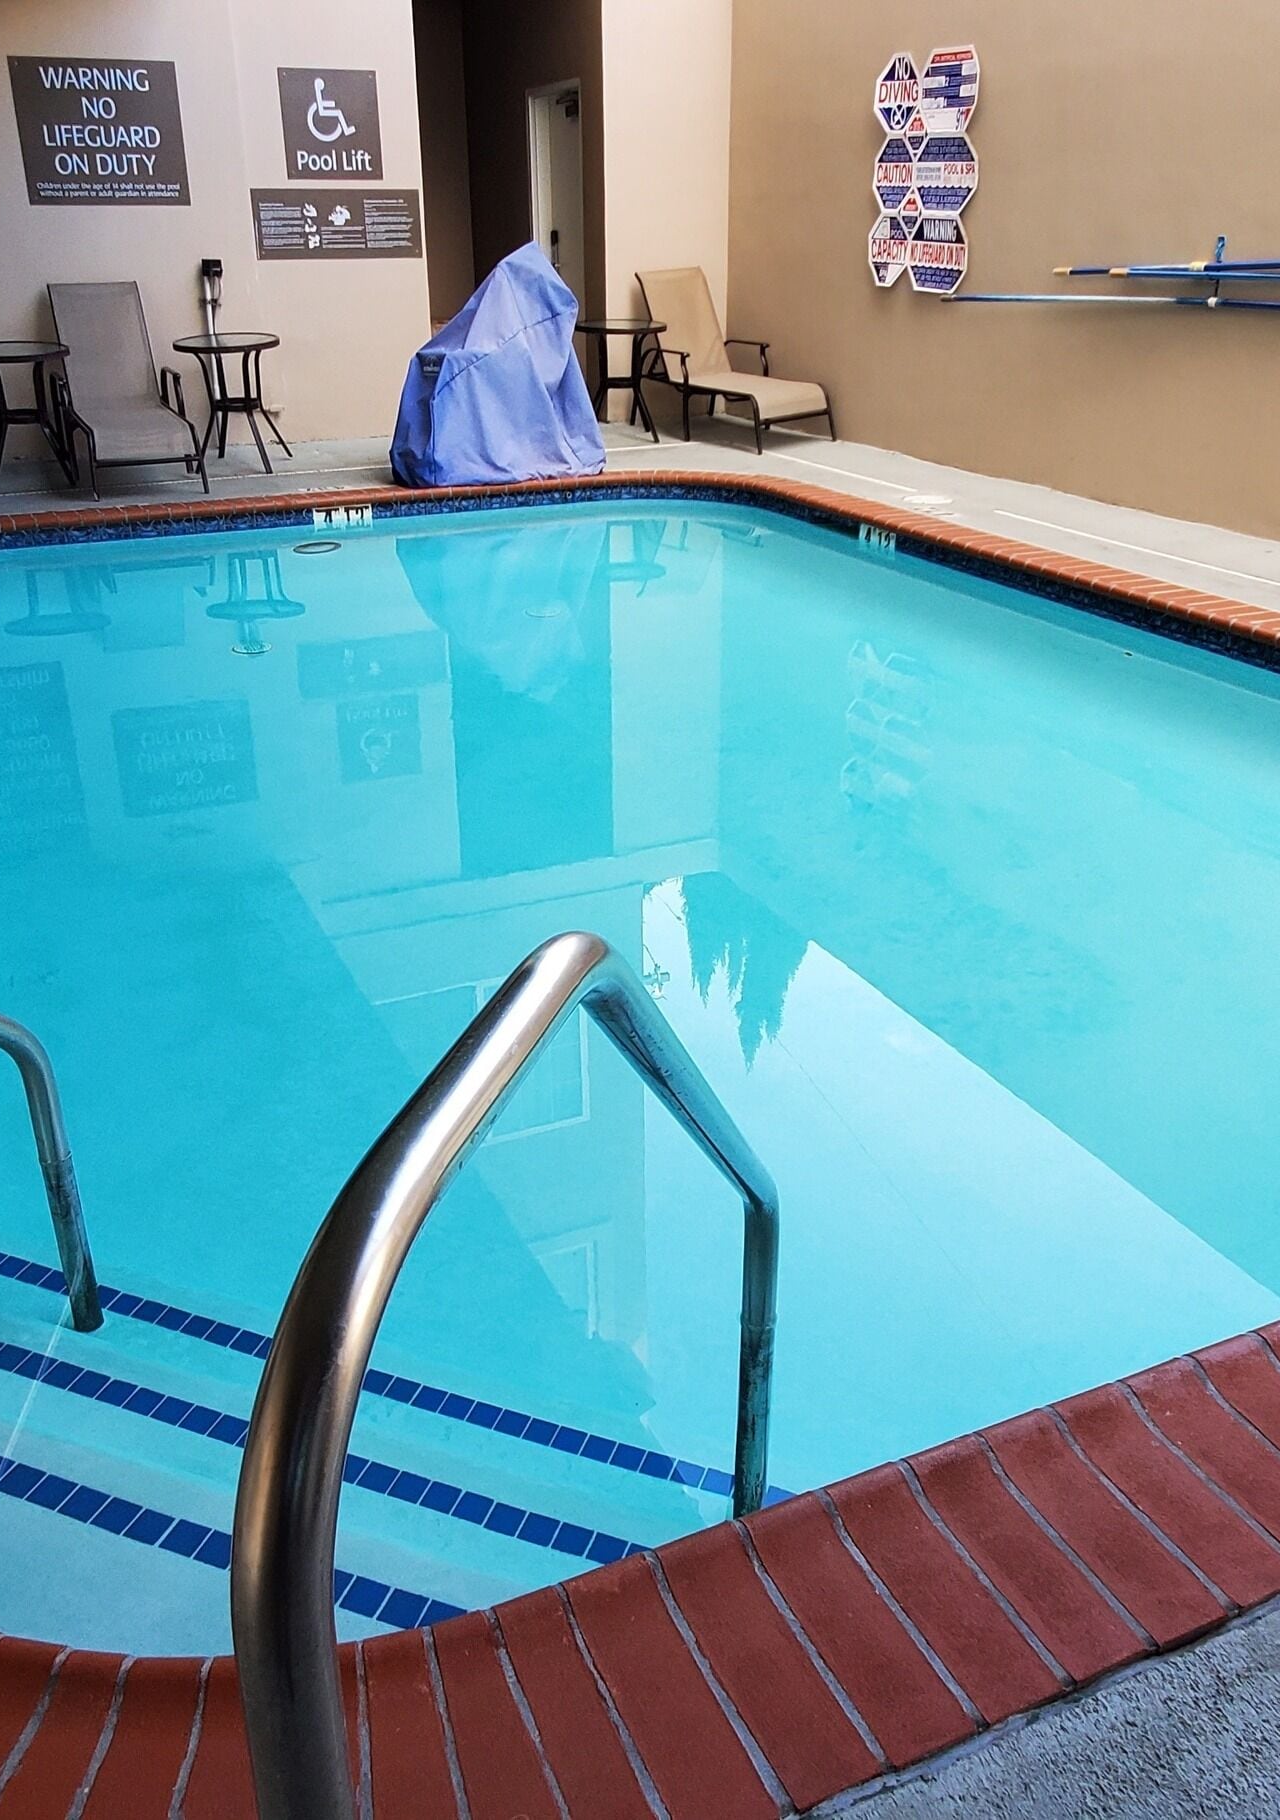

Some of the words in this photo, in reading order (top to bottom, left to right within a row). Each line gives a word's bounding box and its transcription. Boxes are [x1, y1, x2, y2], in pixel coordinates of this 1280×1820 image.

[39, 66, 150, 92] WARNING
[895, 57, 911, 80] NO
[879, 81, 919, 103] DIVING
[81, 96, 116, 119] NO
[42, 124, 161, 148] LIFEGUARD
[54, 153, 90, 175] ON
[95, 153, 156, 175] DUTY
[297, 149, 337, 171] Pool
[342, 149, 373, 171] Lift
[944, 164, 959, 174] POOL
[965, 164, 975, 174] SPA
[877, 164, 912, 183] CAUTION
[890, 229, 904, 239] POOL
[923, 219, 957, 242] WARNING
[872, 241, 908, 261] CAPACITY
[911, 243, 918, 262] NO
[919, 243, 945, 264] LIFEGUARD
